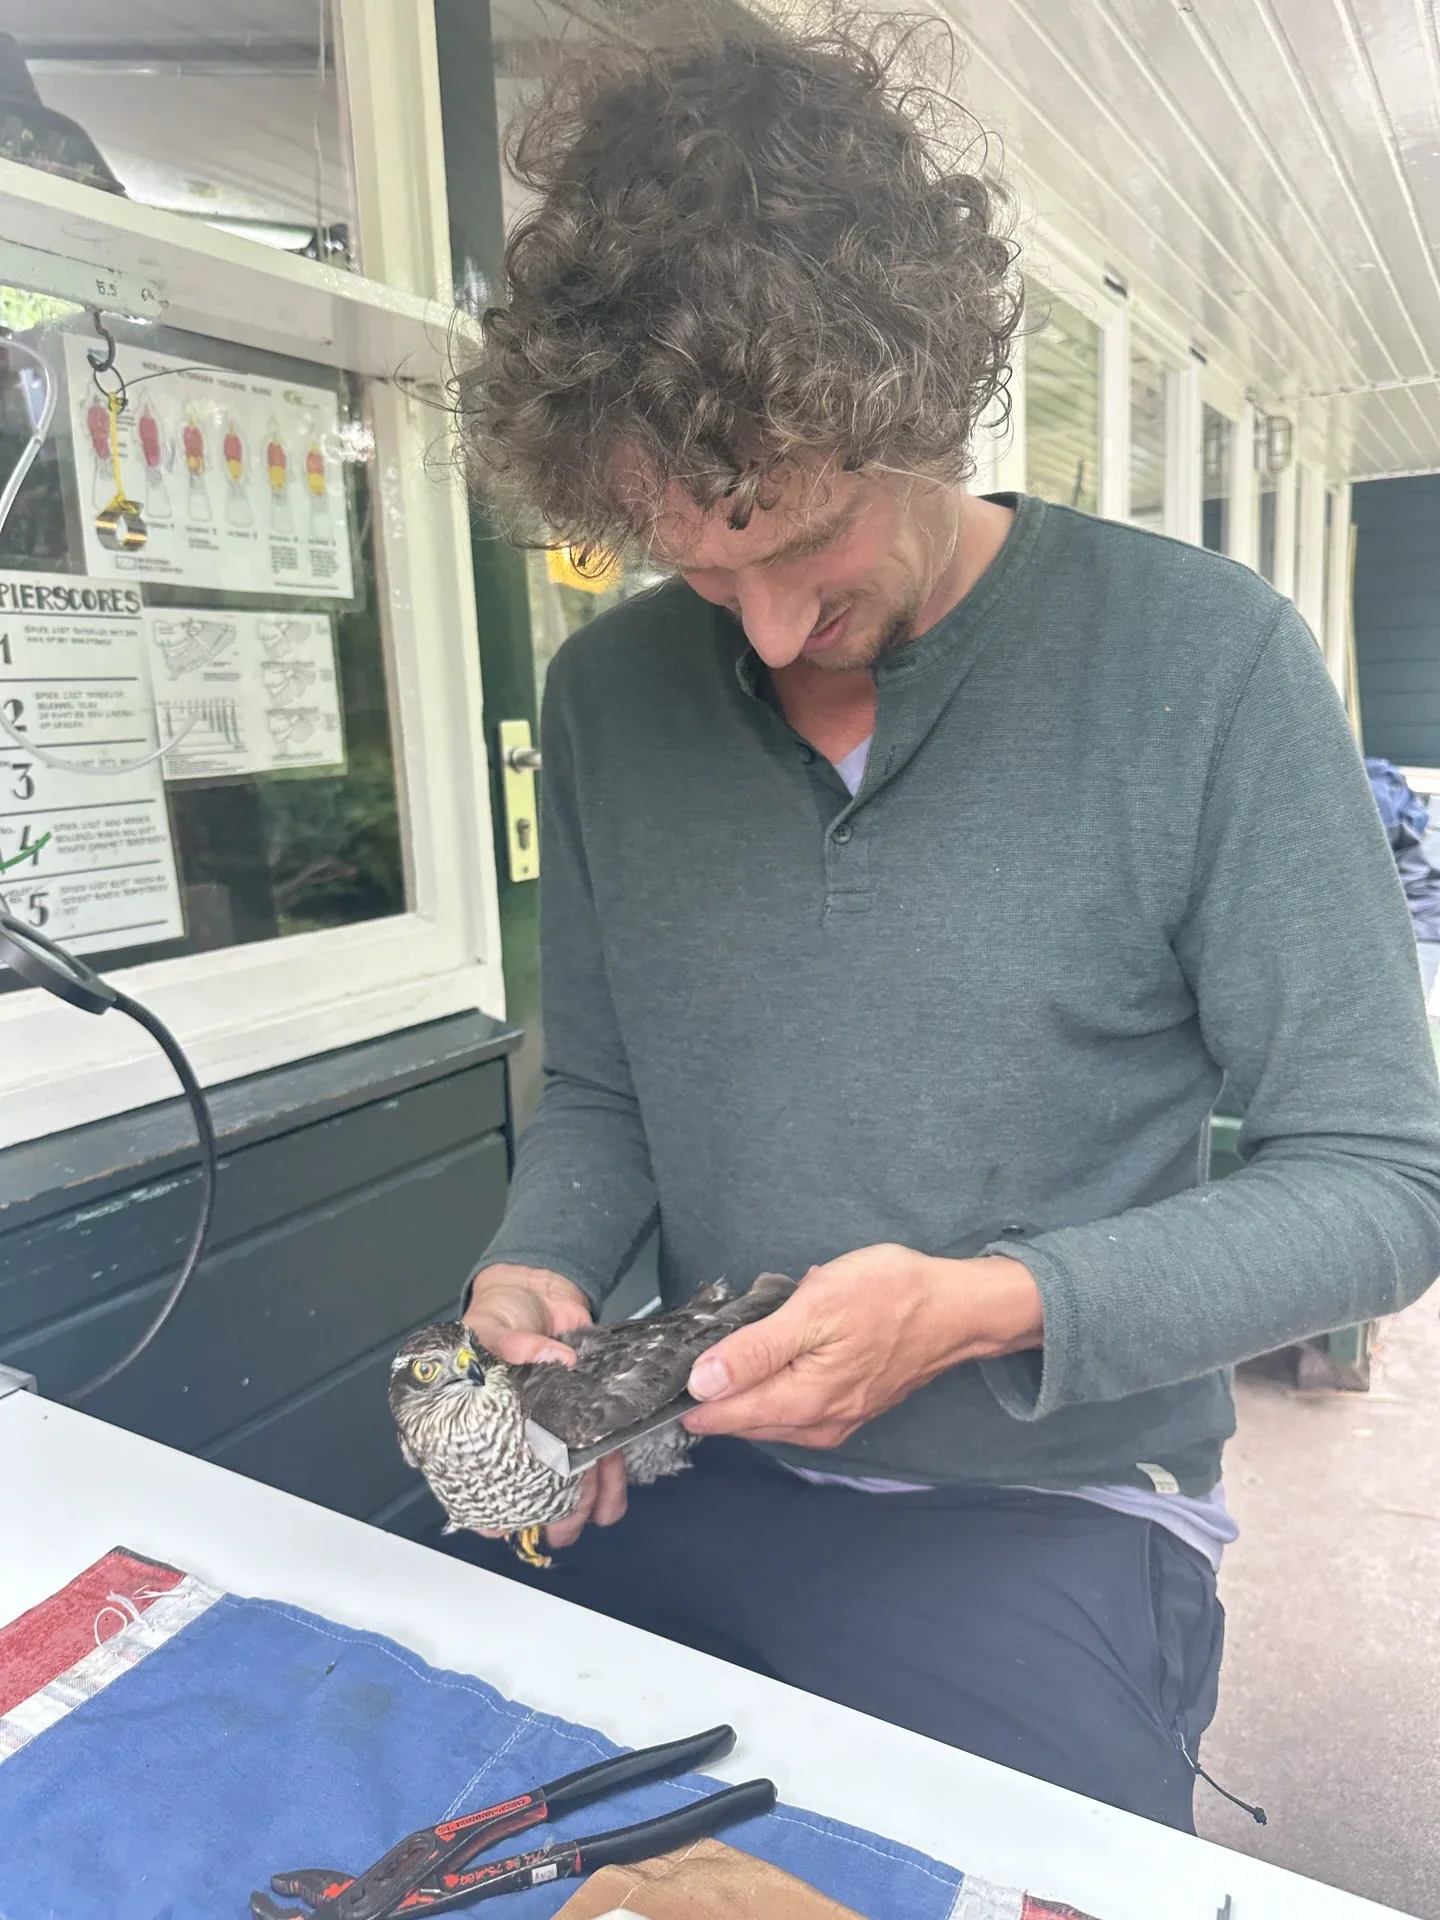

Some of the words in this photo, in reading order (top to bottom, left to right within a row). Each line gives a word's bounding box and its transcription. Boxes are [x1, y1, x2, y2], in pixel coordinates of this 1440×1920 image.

[3, 698, 28, 732] 2
[12, 763, 35, 800] 3
[20, 825, 41, 867] 4
[28, 892, 50, 927] 5
